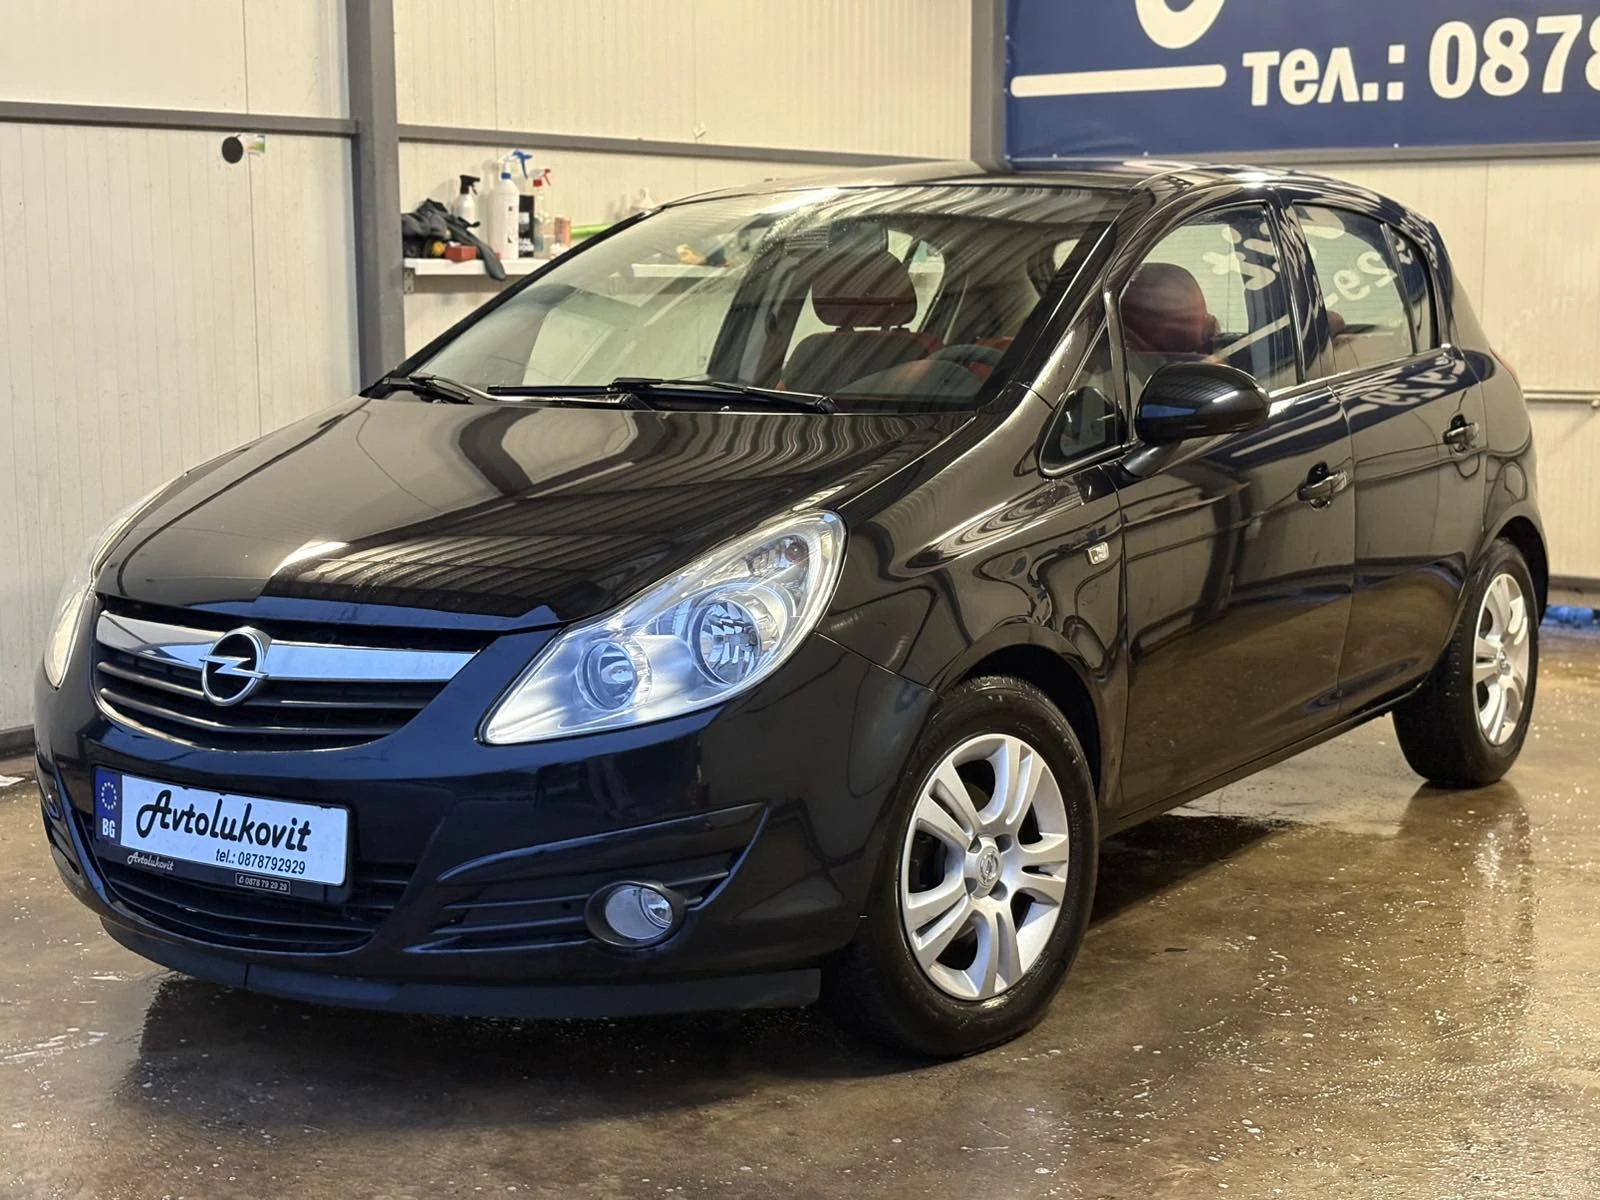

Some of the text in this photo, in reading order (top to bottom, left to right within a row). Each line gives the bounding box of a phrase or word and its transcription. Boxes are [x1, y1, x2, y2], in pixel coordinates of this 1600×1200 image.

[1243, 44, 1405, 106] тел.:
[102, 817, 116, 839] BG
[136, 789, 312, 852] Avtolukovit
[215, 848, 306, 875] tel.: 0878792929
